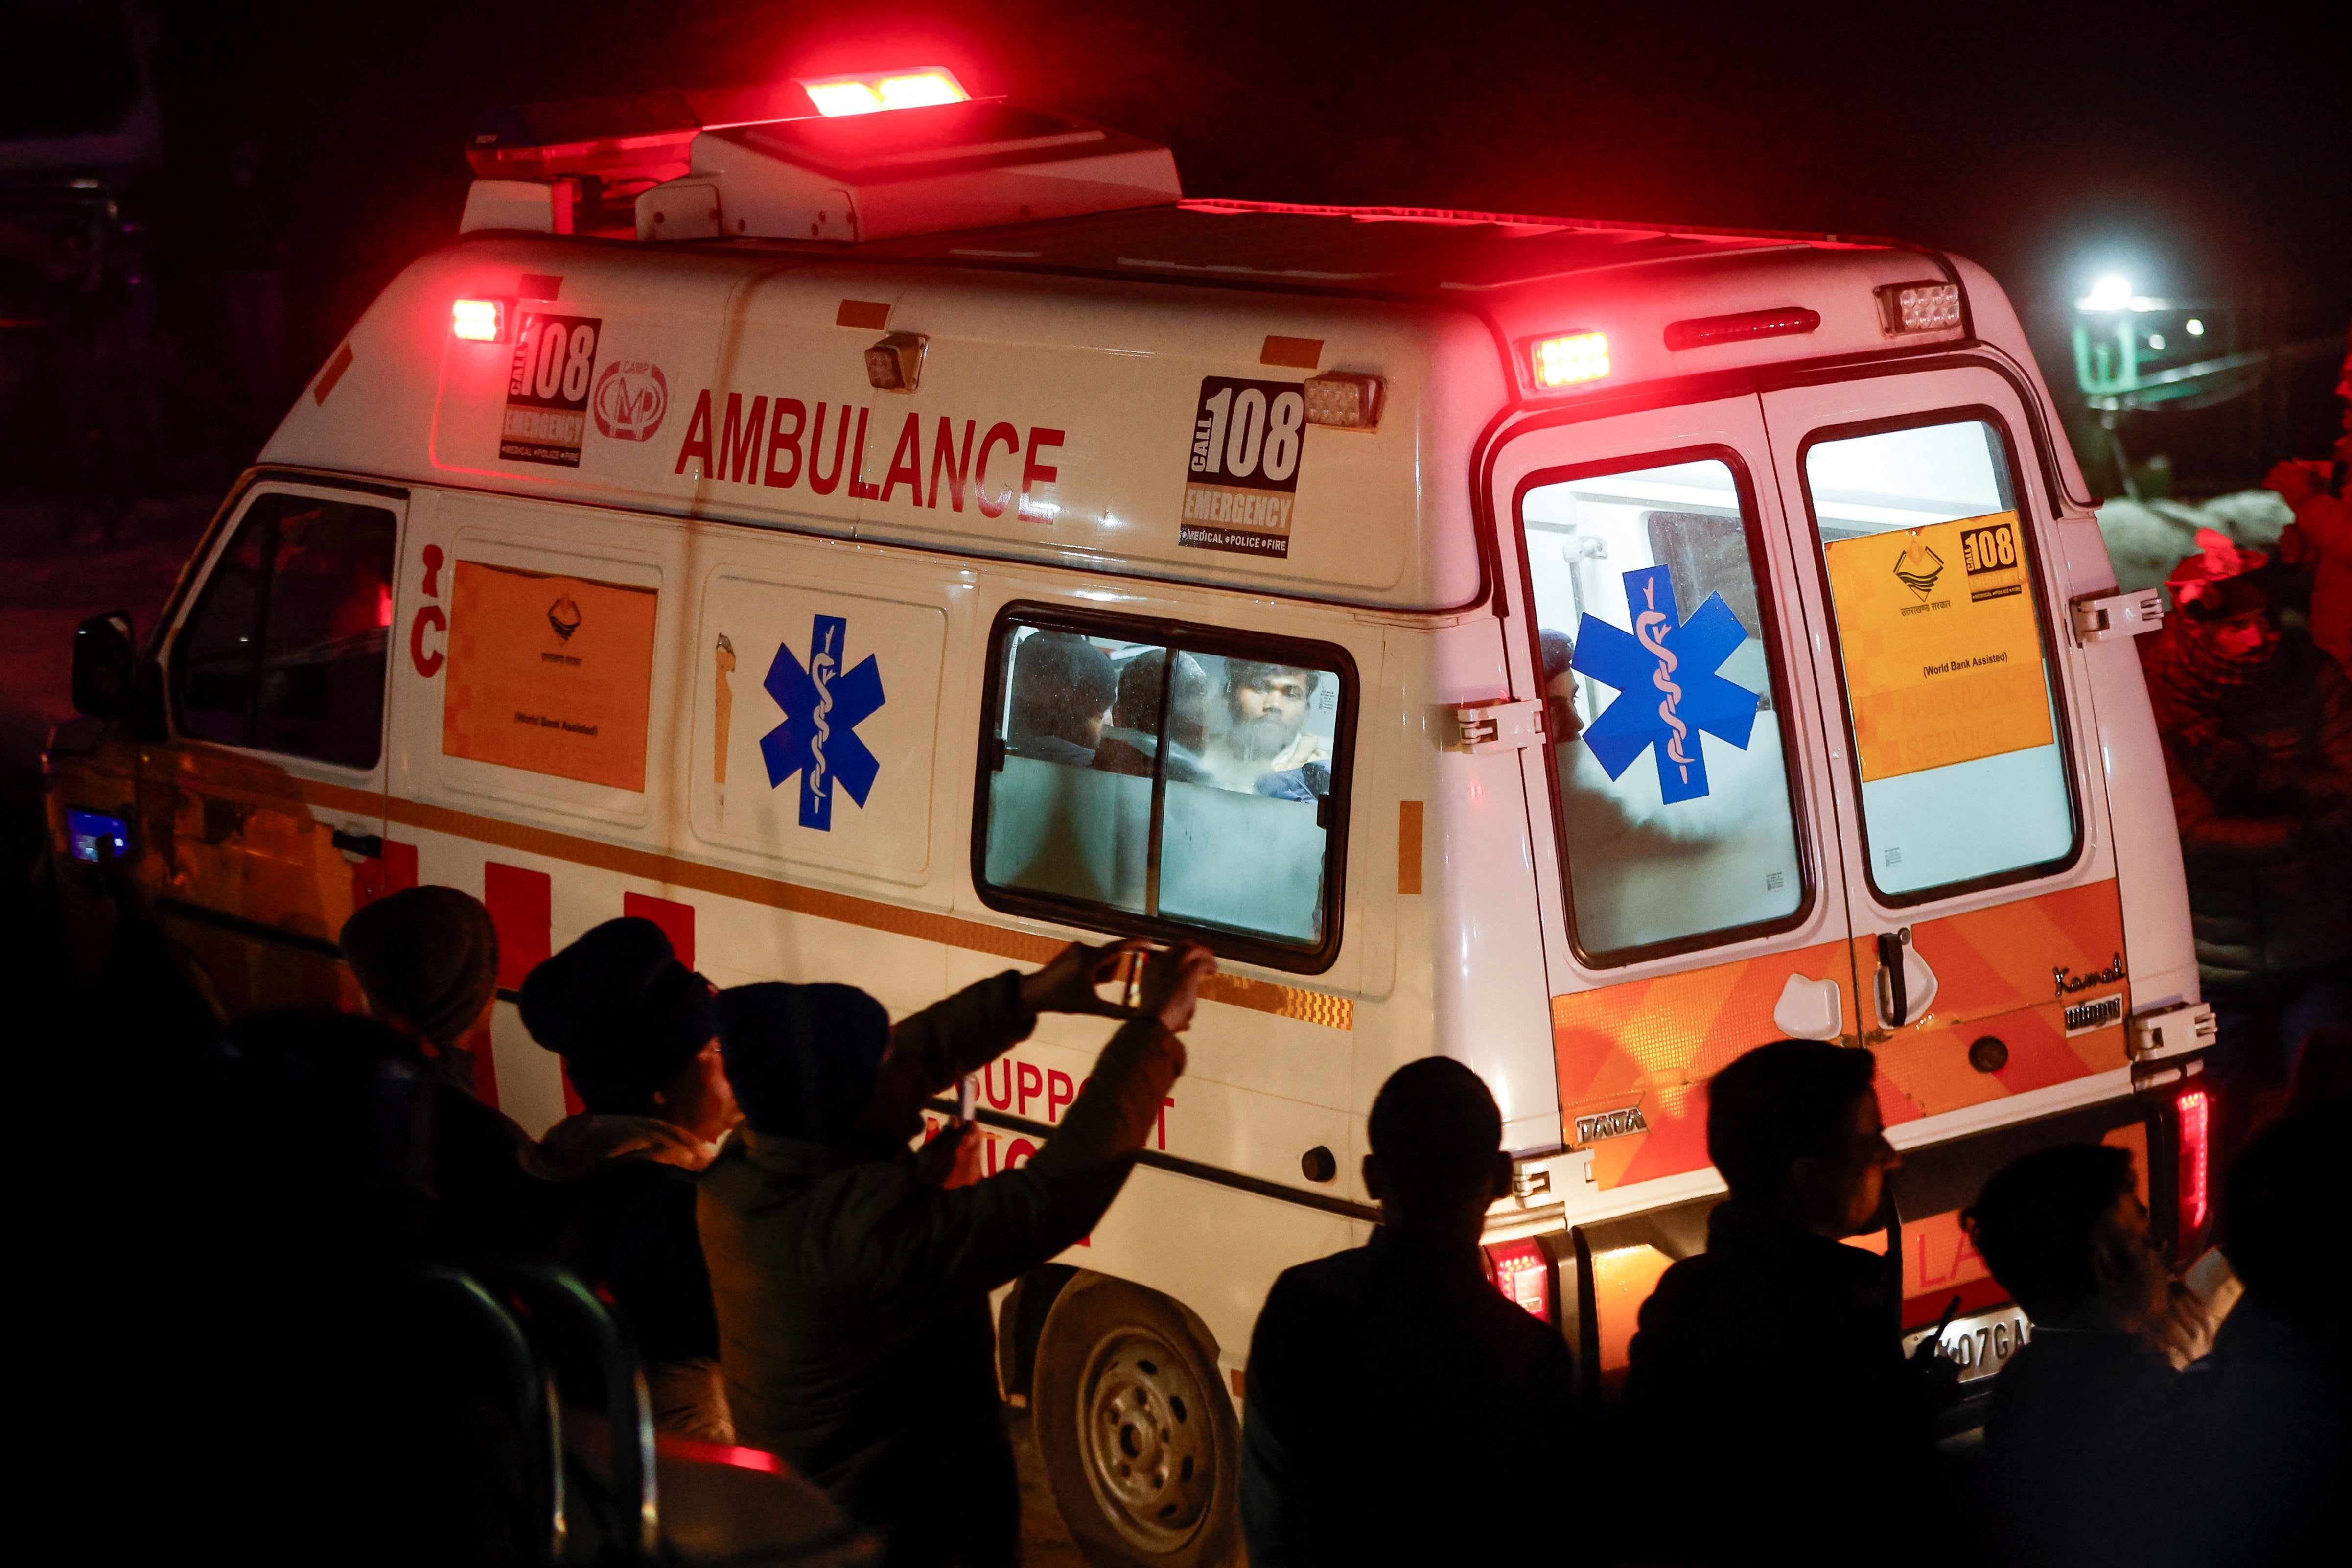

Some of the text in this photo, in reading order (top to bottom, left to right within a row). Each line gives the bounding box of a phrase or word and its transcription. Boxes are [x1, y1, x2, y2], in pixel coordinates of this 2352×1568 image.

[521, 323, 595, 401] 108
[503, 412, 585, 443] EMERGENCY
[1191, 417, 1212, 472] CALL
[1205, 387, 1304, 481] 108
[675, 389, 1066, 525] AMBULANCE
[1185, 489, 1292, 529] EMERGENCY
[1964, 547, 1975, 572] CALL
[1965, 527, 2014, 570] 108
[1931, 600, 1951, 610] सरकार
[1923, 651, 2007, 678] (World Bank Assisted)
[2052, 952, 2125, 996] Kamal
[957, 1058, 1174, 1150] UPPT
[1578, 1108, 1648, 1142] TATA
